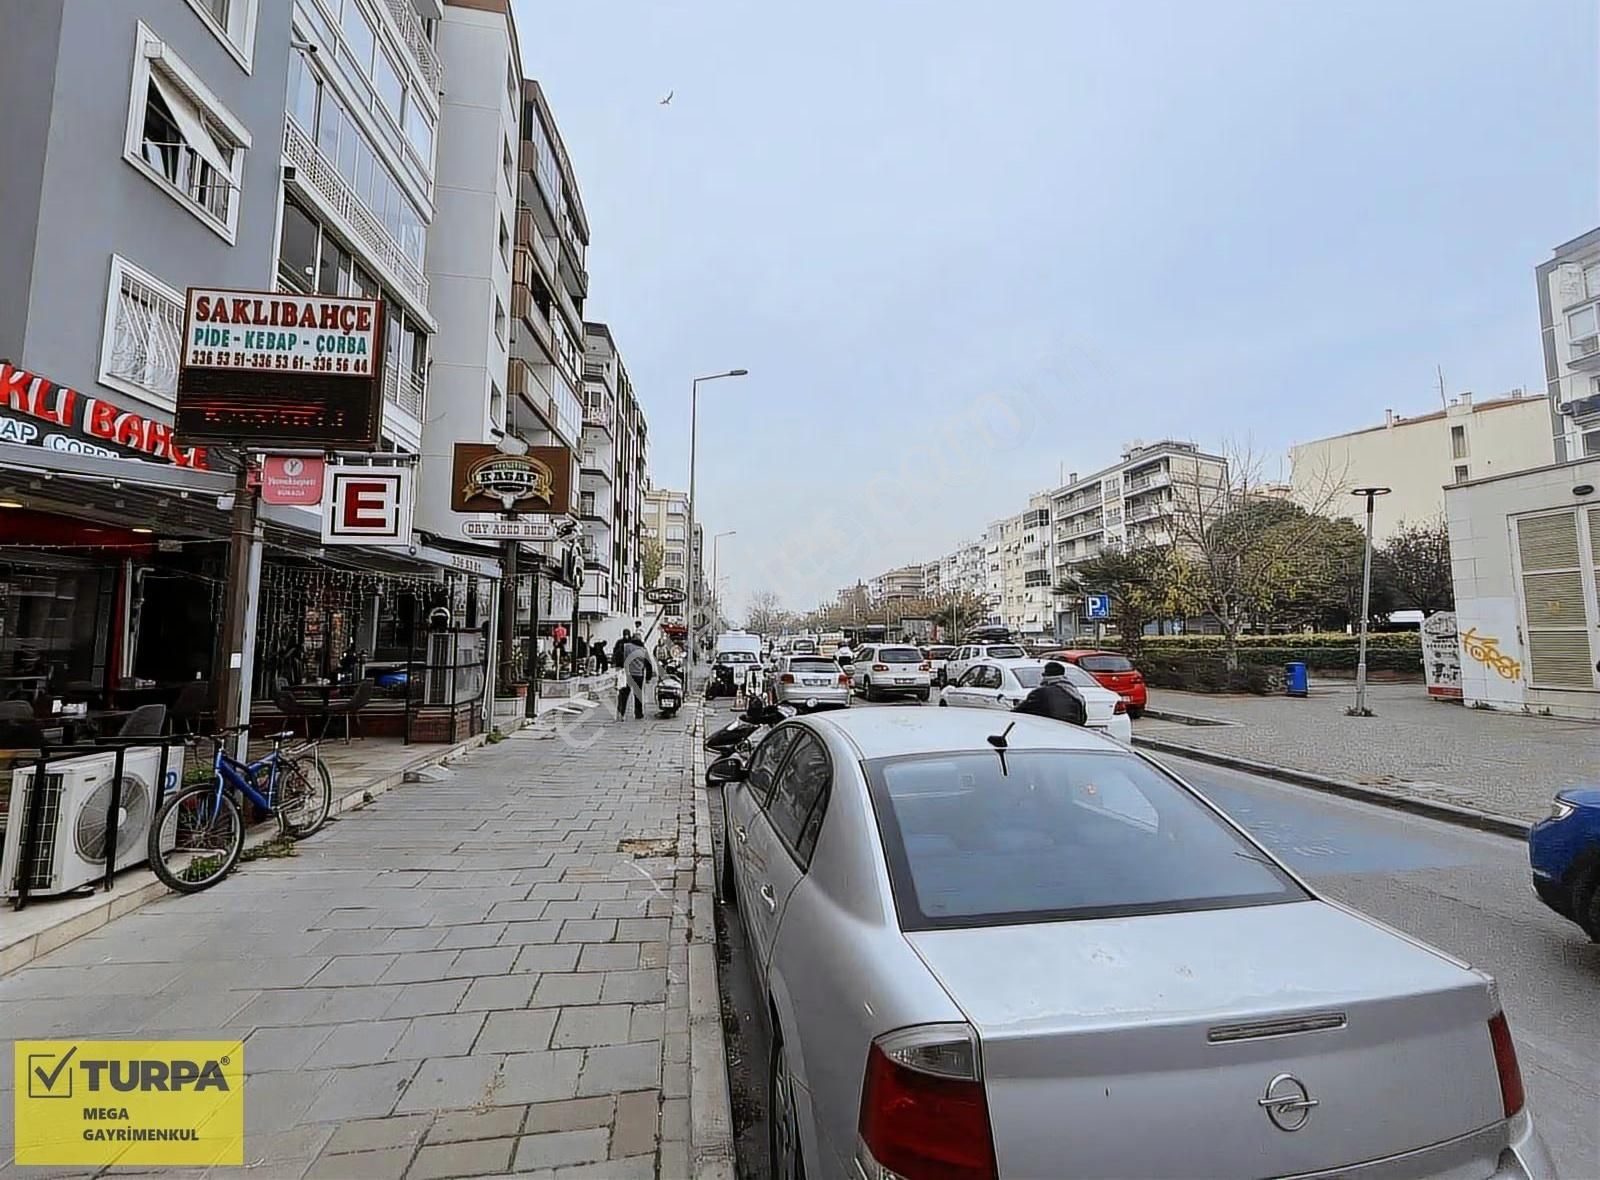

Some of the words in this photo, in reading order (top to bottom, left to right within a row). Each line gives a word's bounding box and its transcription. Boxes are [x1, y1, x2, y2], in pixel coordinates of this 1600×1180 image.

[195, 296, 371, 335] SAKLIBAHÇE
[194, 324, 230, 347] PİDE
[244, 330, 297, 351] KEBAP
[316, 335, 367, 356] ÇORBA
[192, 350, 212, 365] 336
[216, 351, 230, 365] 53
[275, 354, 288, 368] 53
[354, 359, 368, 373] 44
[343, 482, 387, 528] E
[1088, 597, 1101, 616] P
